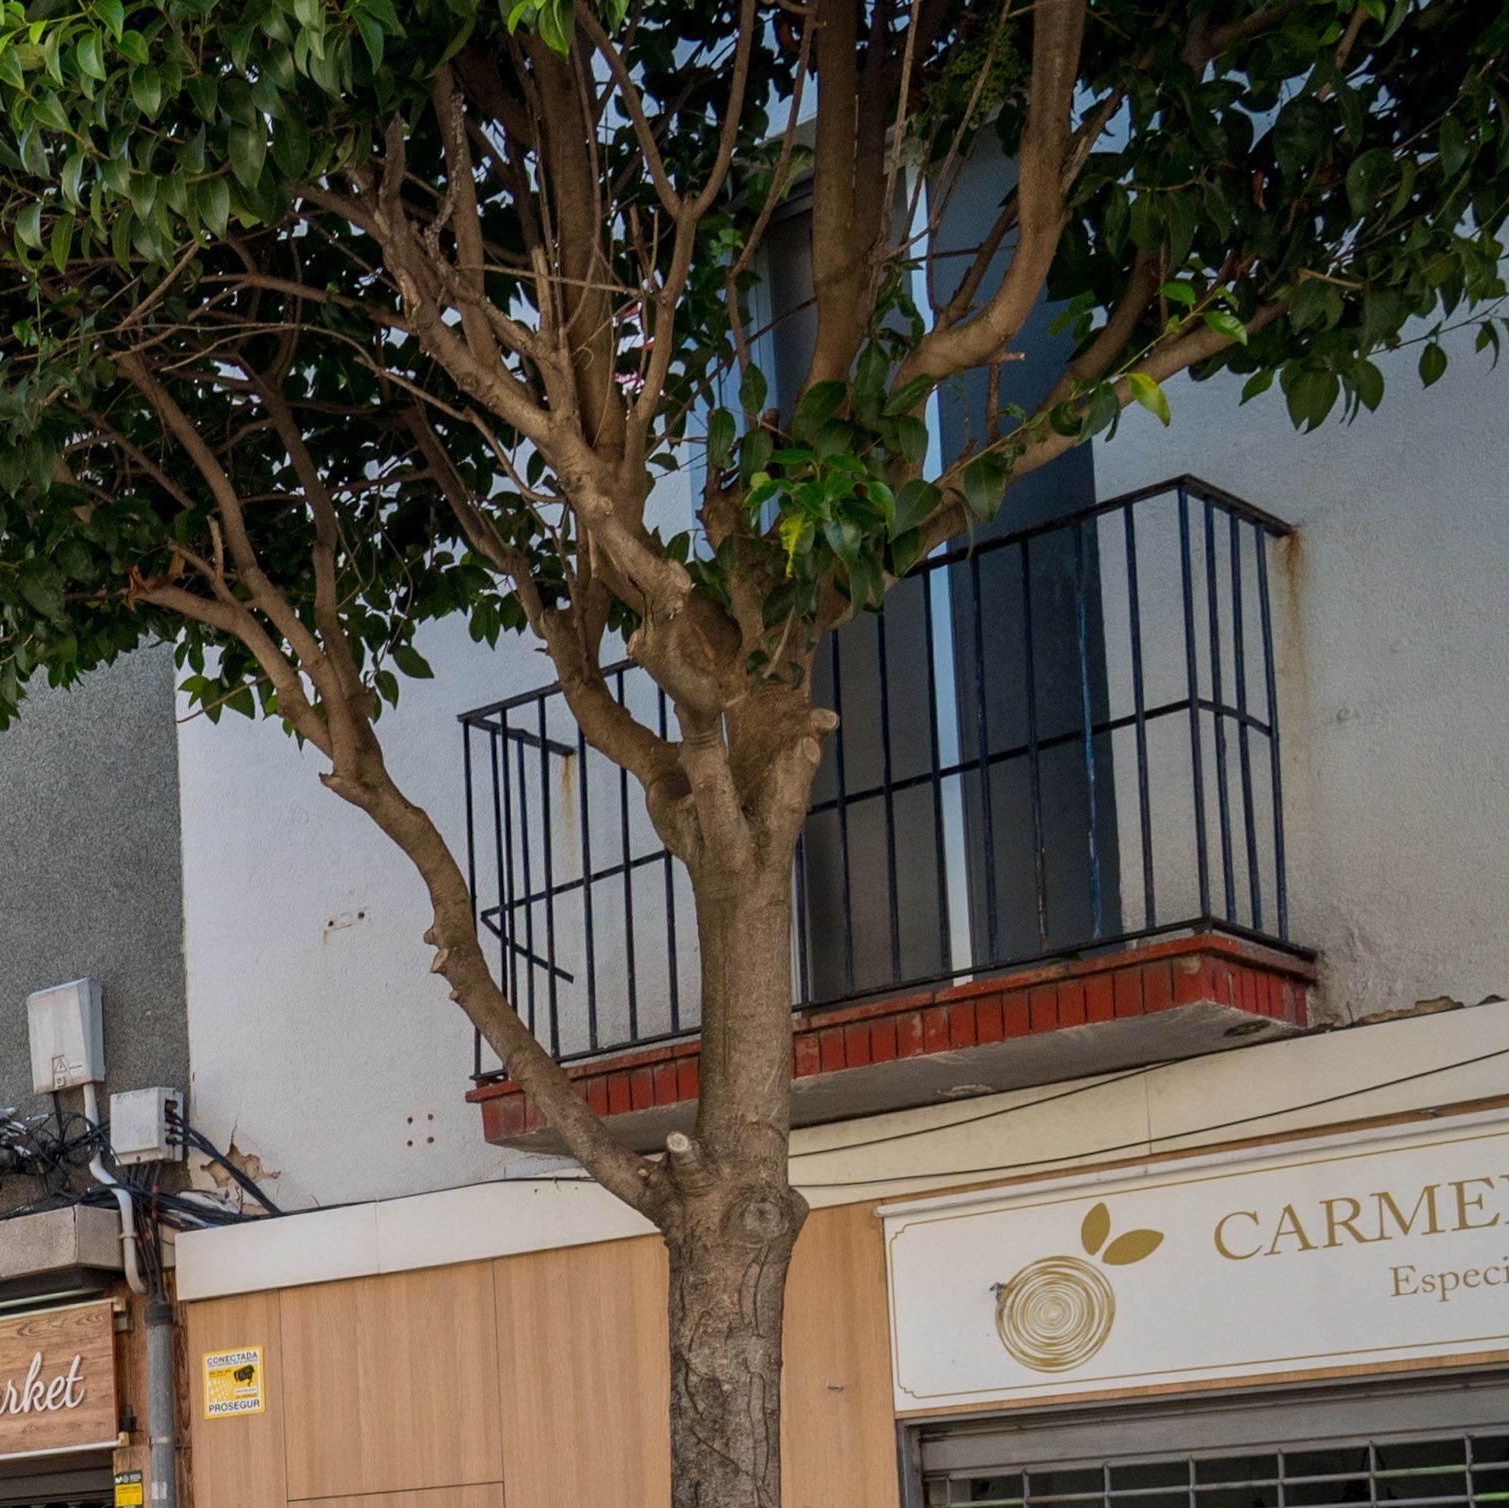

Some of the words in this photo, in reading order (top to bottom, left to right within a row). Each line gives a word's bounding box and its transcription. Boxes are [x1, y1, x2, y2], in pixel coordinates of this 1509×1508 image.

[1213, 1173, 1509, 1261] CARME
[206, 1351, 258, 1366] CONECTADA
[208, 1398, 261, 1413] PROSEGUR
